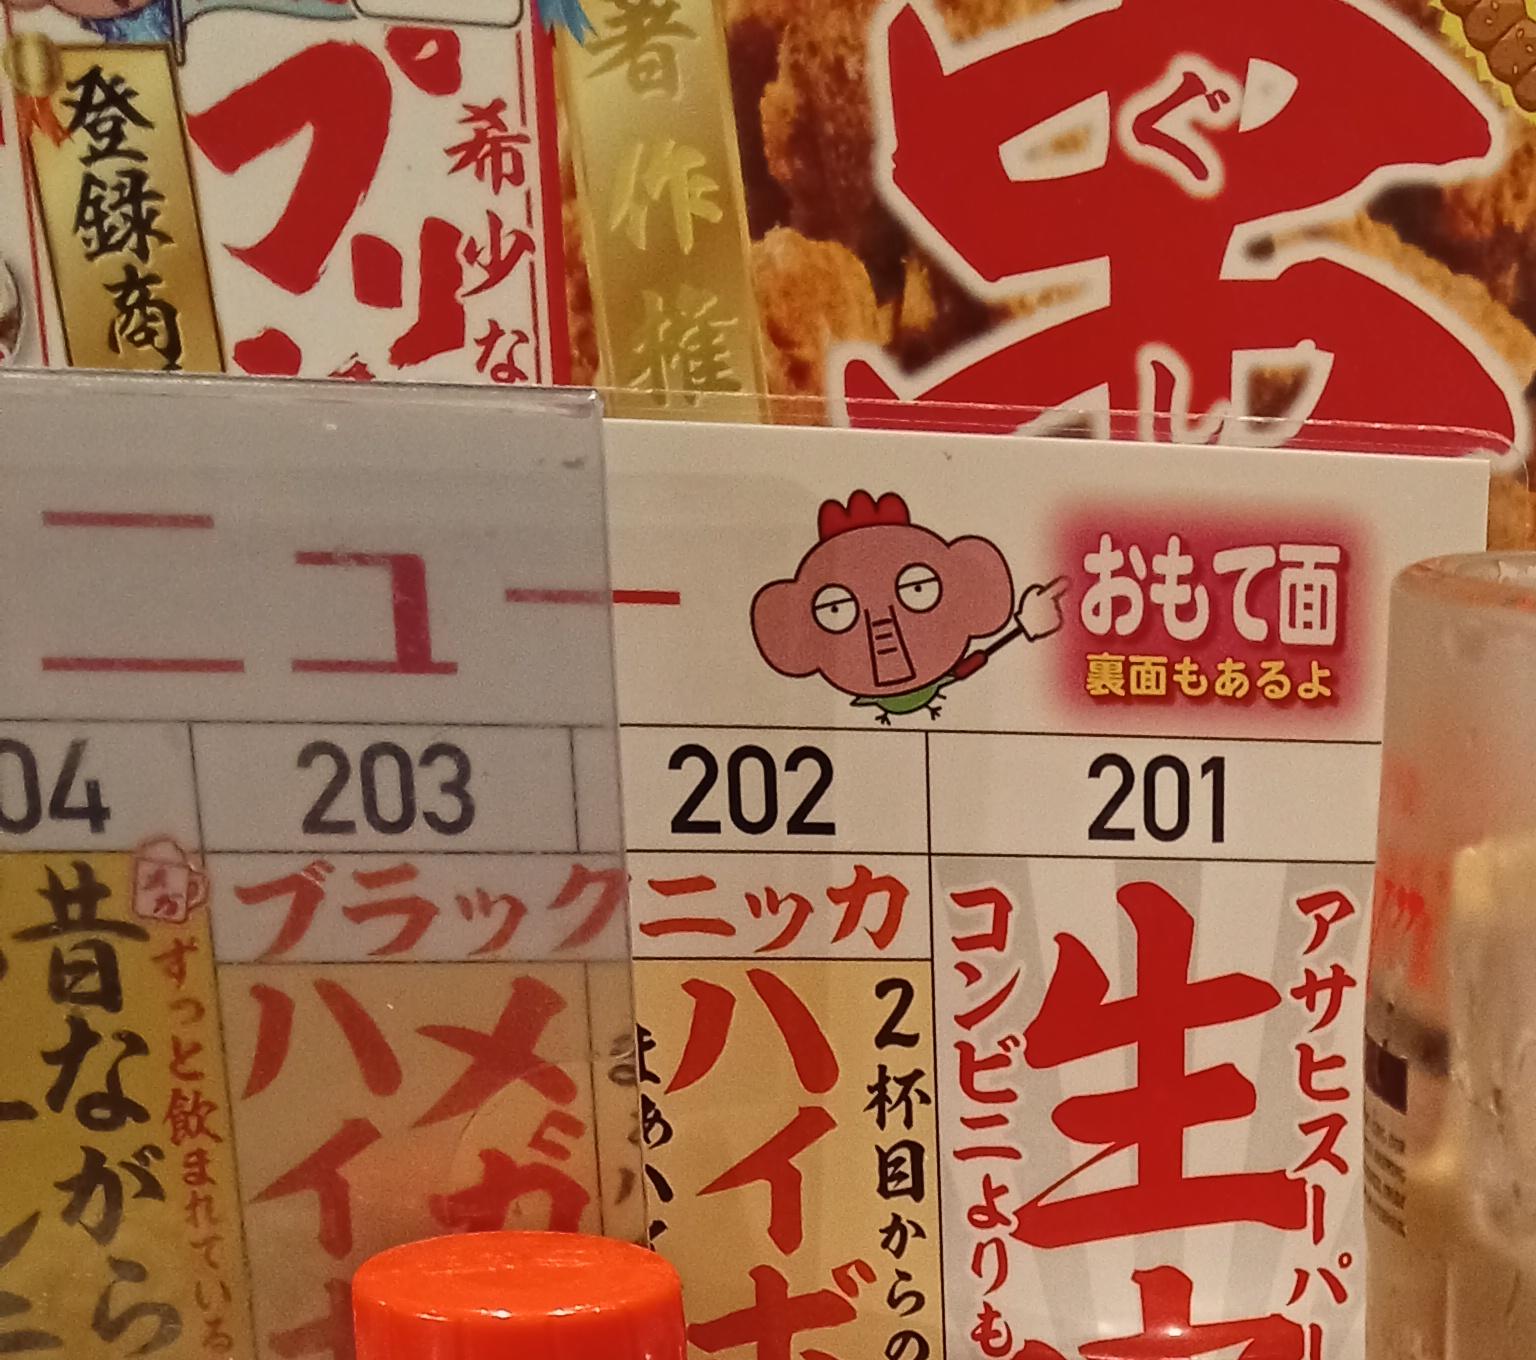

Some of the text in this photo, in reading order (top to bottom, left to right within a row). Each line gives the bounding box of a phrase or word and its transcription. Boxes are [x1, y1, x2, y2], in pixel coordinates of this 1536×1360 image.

[60, 65, 183, 370] 登録商
[445, 99, 535, 382] 希少な
[1080, 533, 1342, 647] おもて面
[1085, 652, 1334, 700] 裏面もあるよ
[297, 740, 476, 836] 203
[667, 743, 838, 836] 202
[1086, 752, 1226, 843] 201
[233, 859, 633, 963] ブラック
[638, 864, 910, 953] ニッカ
